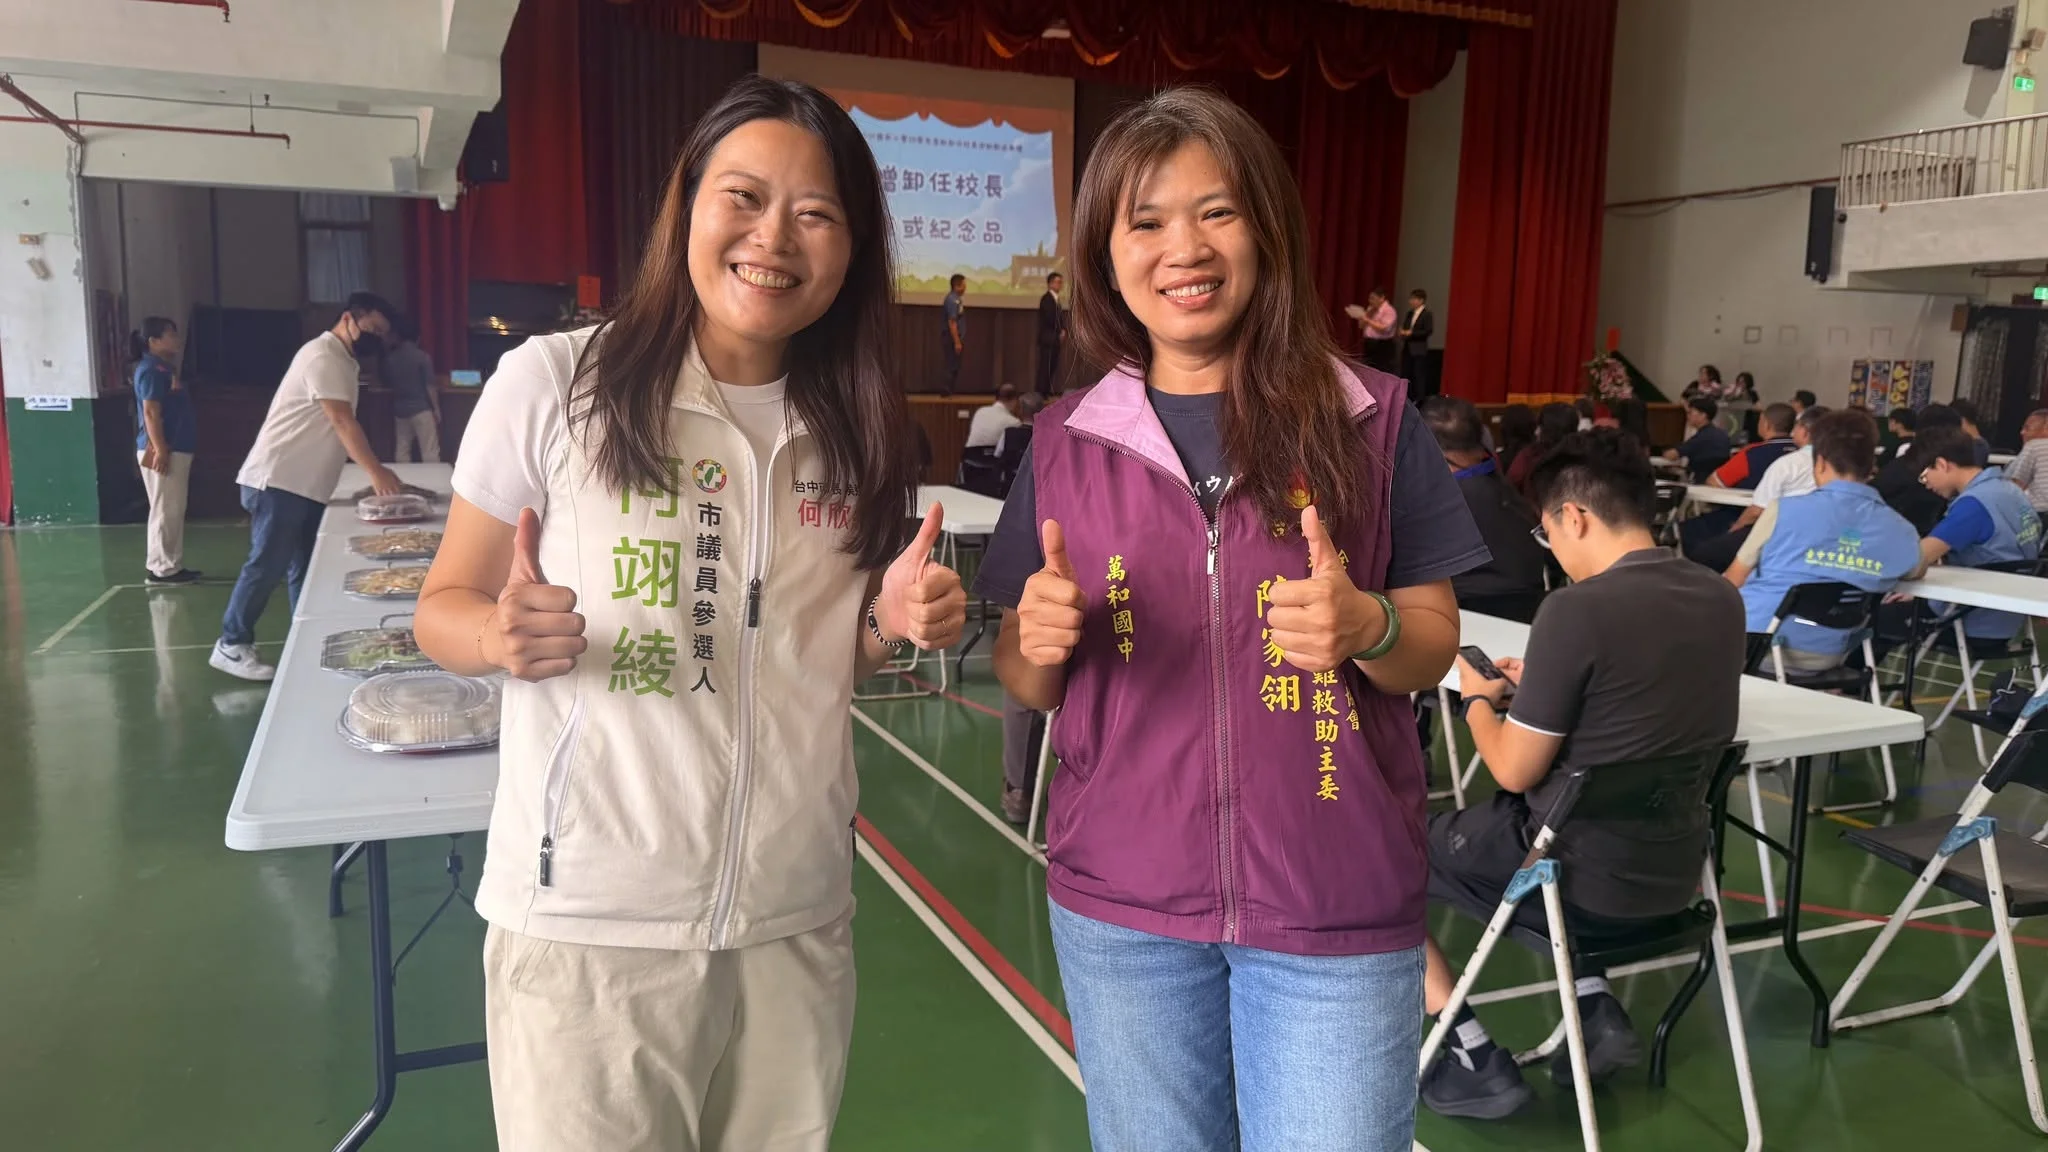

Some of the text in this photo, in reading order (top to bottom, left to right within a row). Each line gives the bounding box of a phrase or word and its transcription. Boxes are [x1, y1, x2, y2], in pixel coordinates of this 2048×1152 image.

[903, 216, 1003, 244] 或紀念品
[690, 502, 722, 694] 市議員參選人
[1105, 555, 1134, 663] 萬和國中
